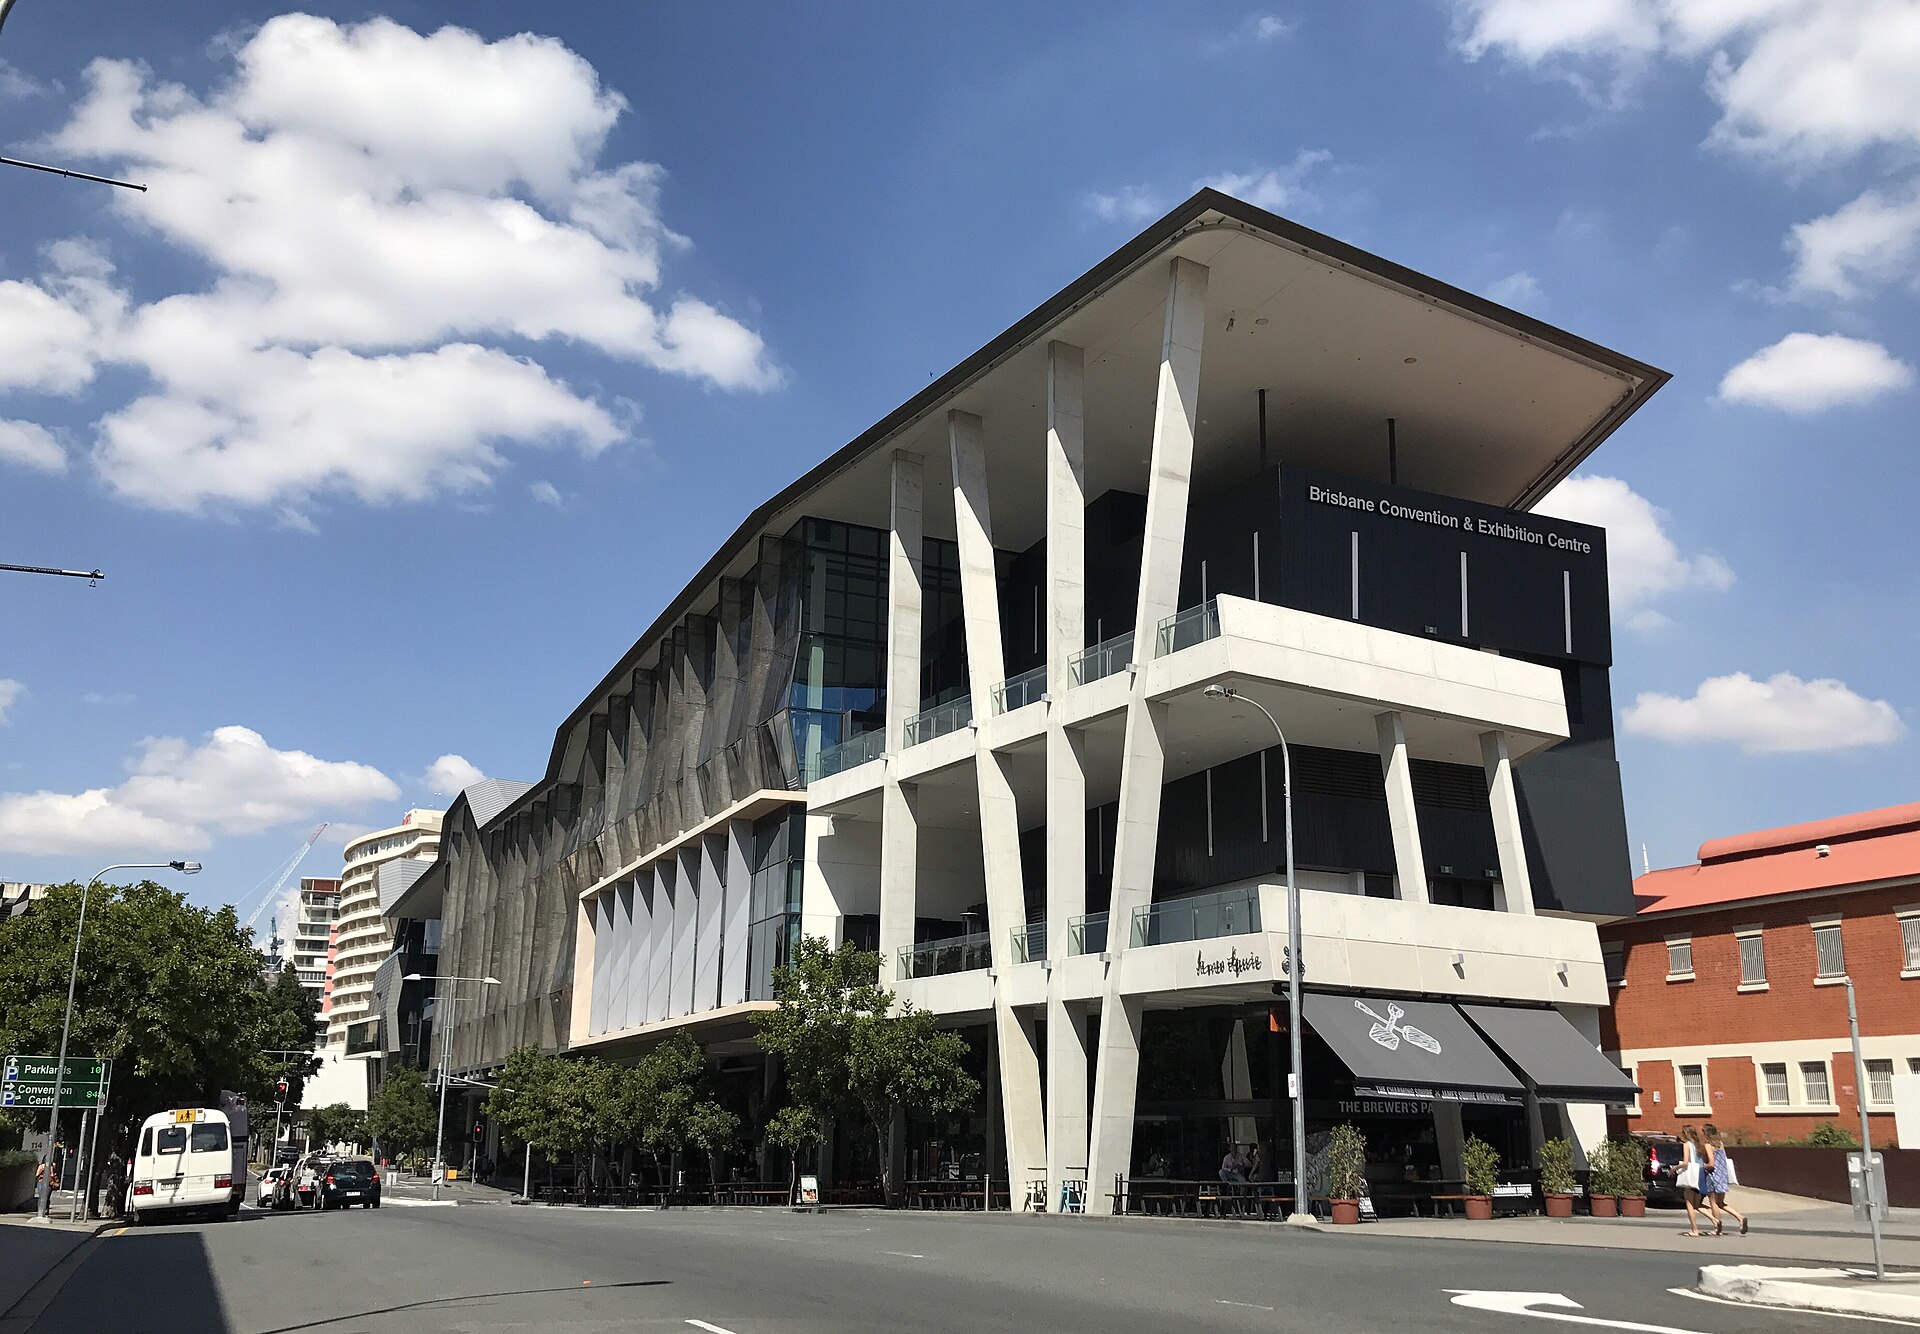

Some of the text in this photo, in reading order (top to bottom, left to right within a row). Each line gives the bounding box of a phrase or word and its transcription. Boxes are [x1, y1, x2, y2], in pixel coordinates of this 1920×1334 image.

[1309, 485, 1591, 554] Brisbane Convention & Exhibition Centre
[18, 1084, 100, 1099] Convenon 84
[28, 1095, 56, 1105] Centr
[1339, 1101, 1360, 1113] THE
[1363, 1101, 1418, 1114] BREWER'S
